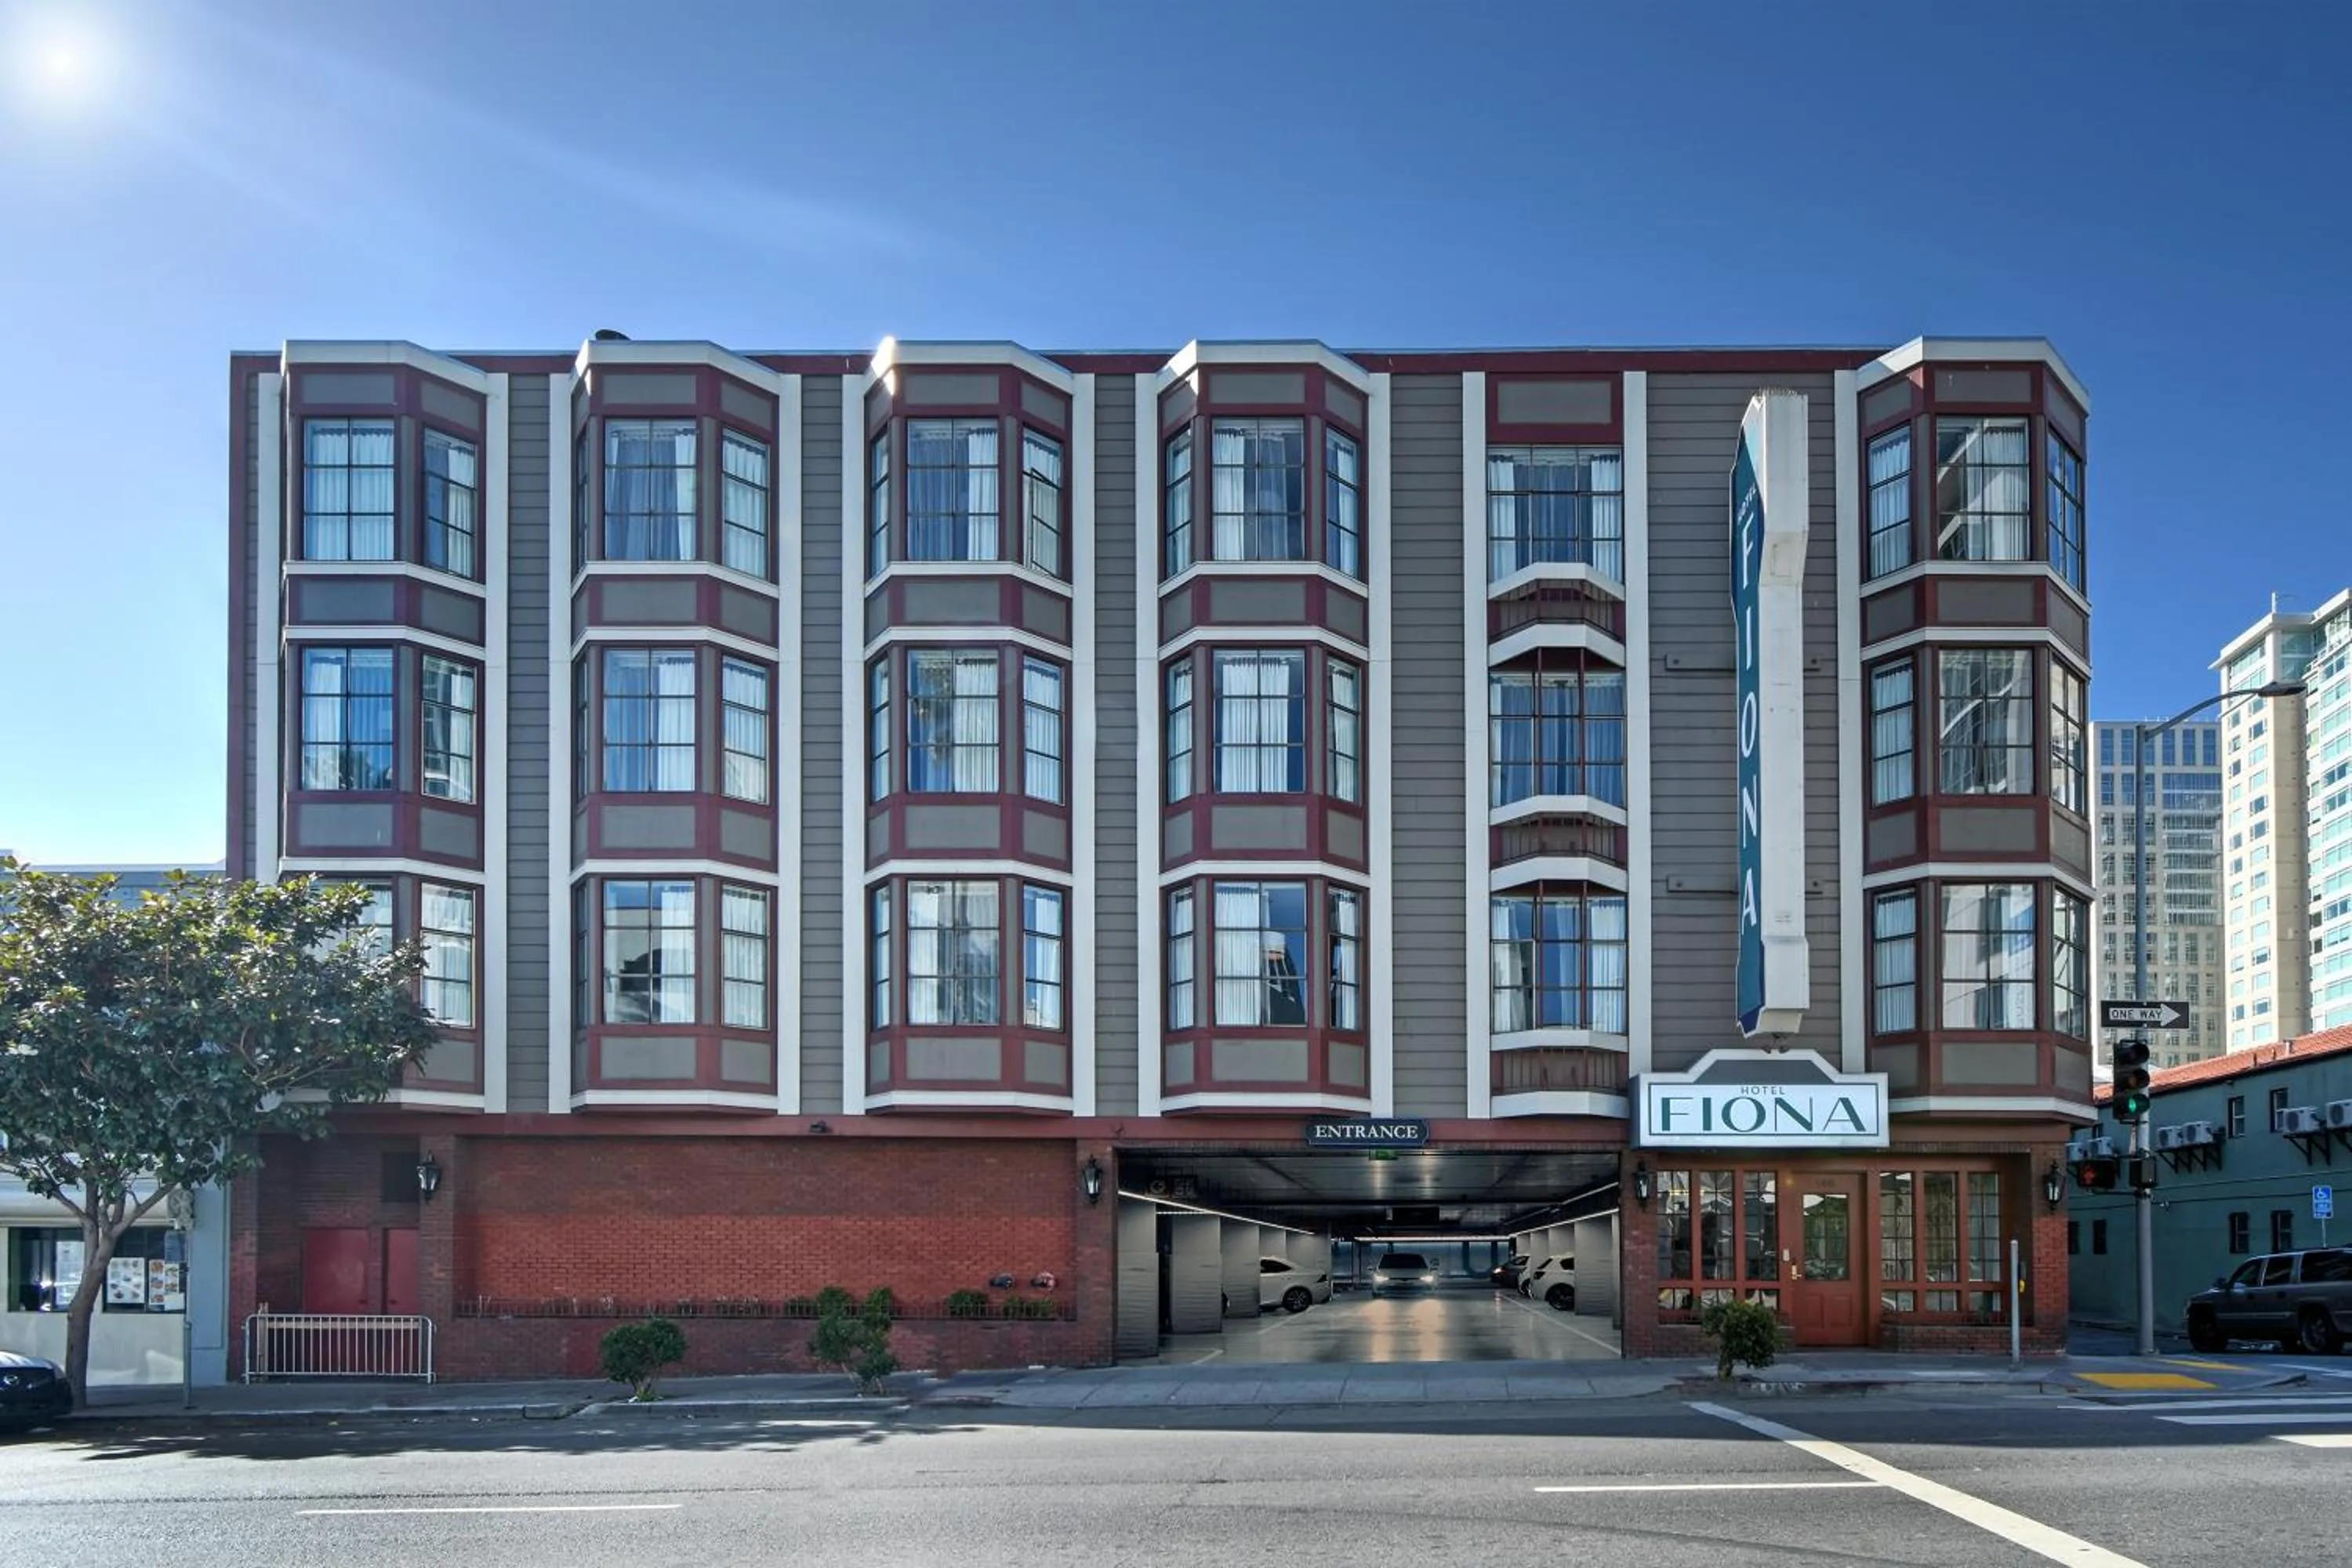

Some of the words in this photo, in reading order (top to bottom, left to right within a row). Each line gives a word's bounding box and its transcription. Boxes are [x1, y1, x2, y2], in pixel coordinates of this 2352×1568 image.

[1741, 512, 1757, 935] FIONA
[2112, 1009, 2132, 1018] ONE
[2140, 1008, 2161, 1018] WAY
[1740, 1087, 1785, 1095] HOTEL
[1661, 1097, 1867, 1132] FIONA
[1316, 1125, 1418, 1138] ENTRANCE
